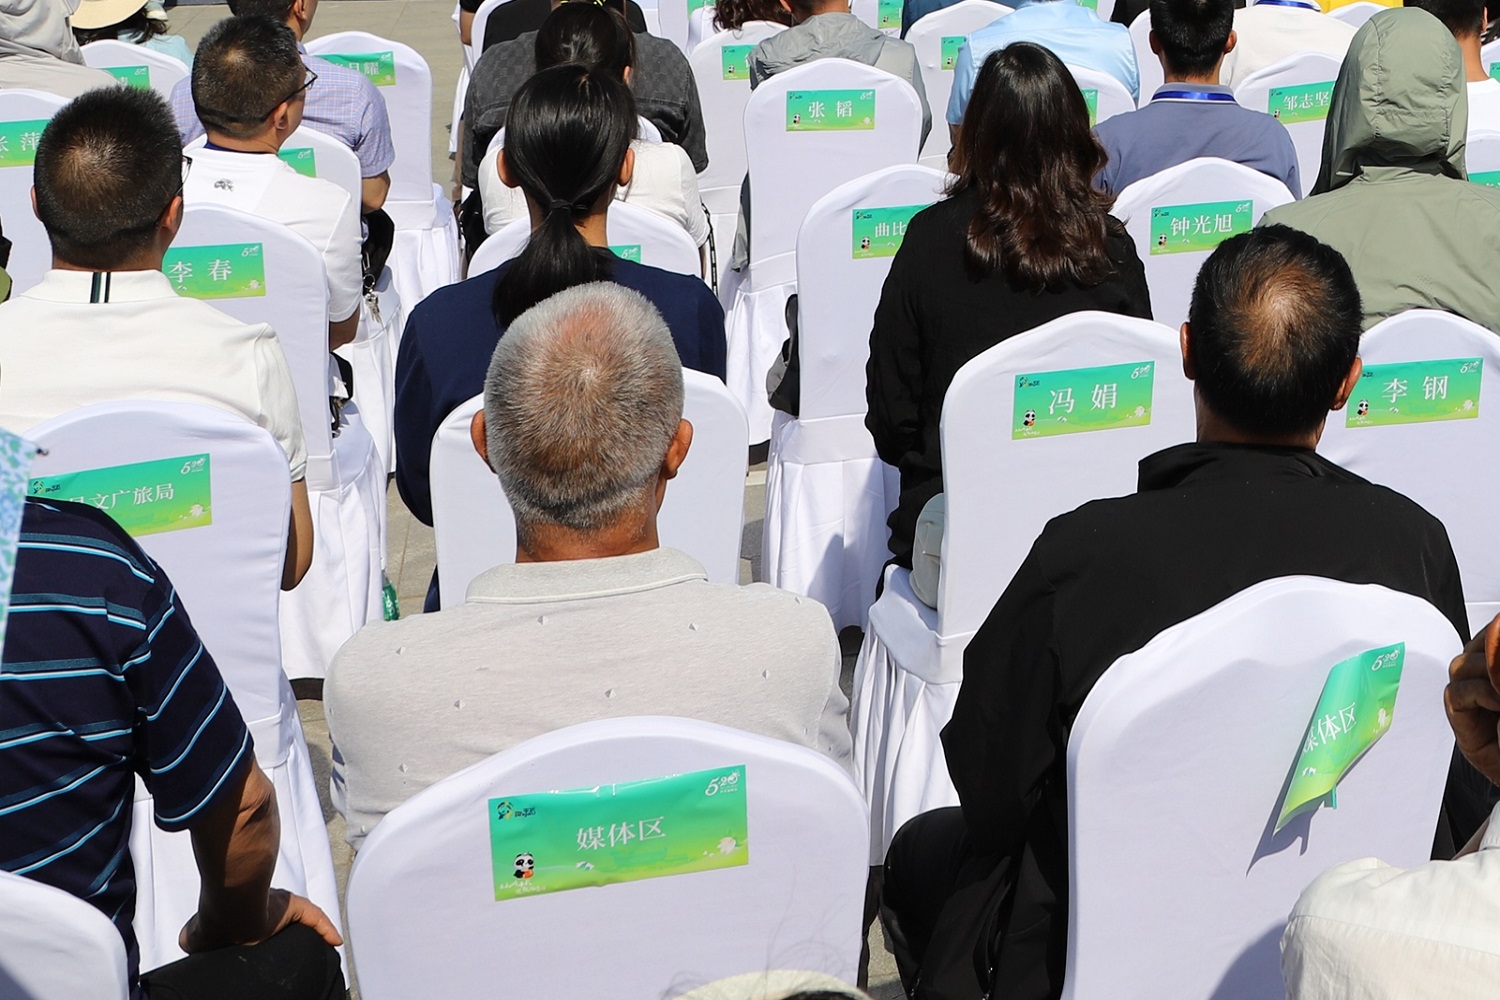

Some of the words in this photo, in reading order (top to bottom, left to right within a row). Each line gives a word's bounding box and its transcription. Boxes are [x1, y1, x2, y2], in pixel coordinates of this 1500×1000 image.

[808, 100, 853, 118] 张韬
[1170, 213, 1233, 237] 钟光旭
[168, 258, 233, 285] 李春
[1048, 382, 1118, 416] 冯娟
[1381, 374, 1449, 405] 李钢
[575, 815, 667, 852] 媒体区
